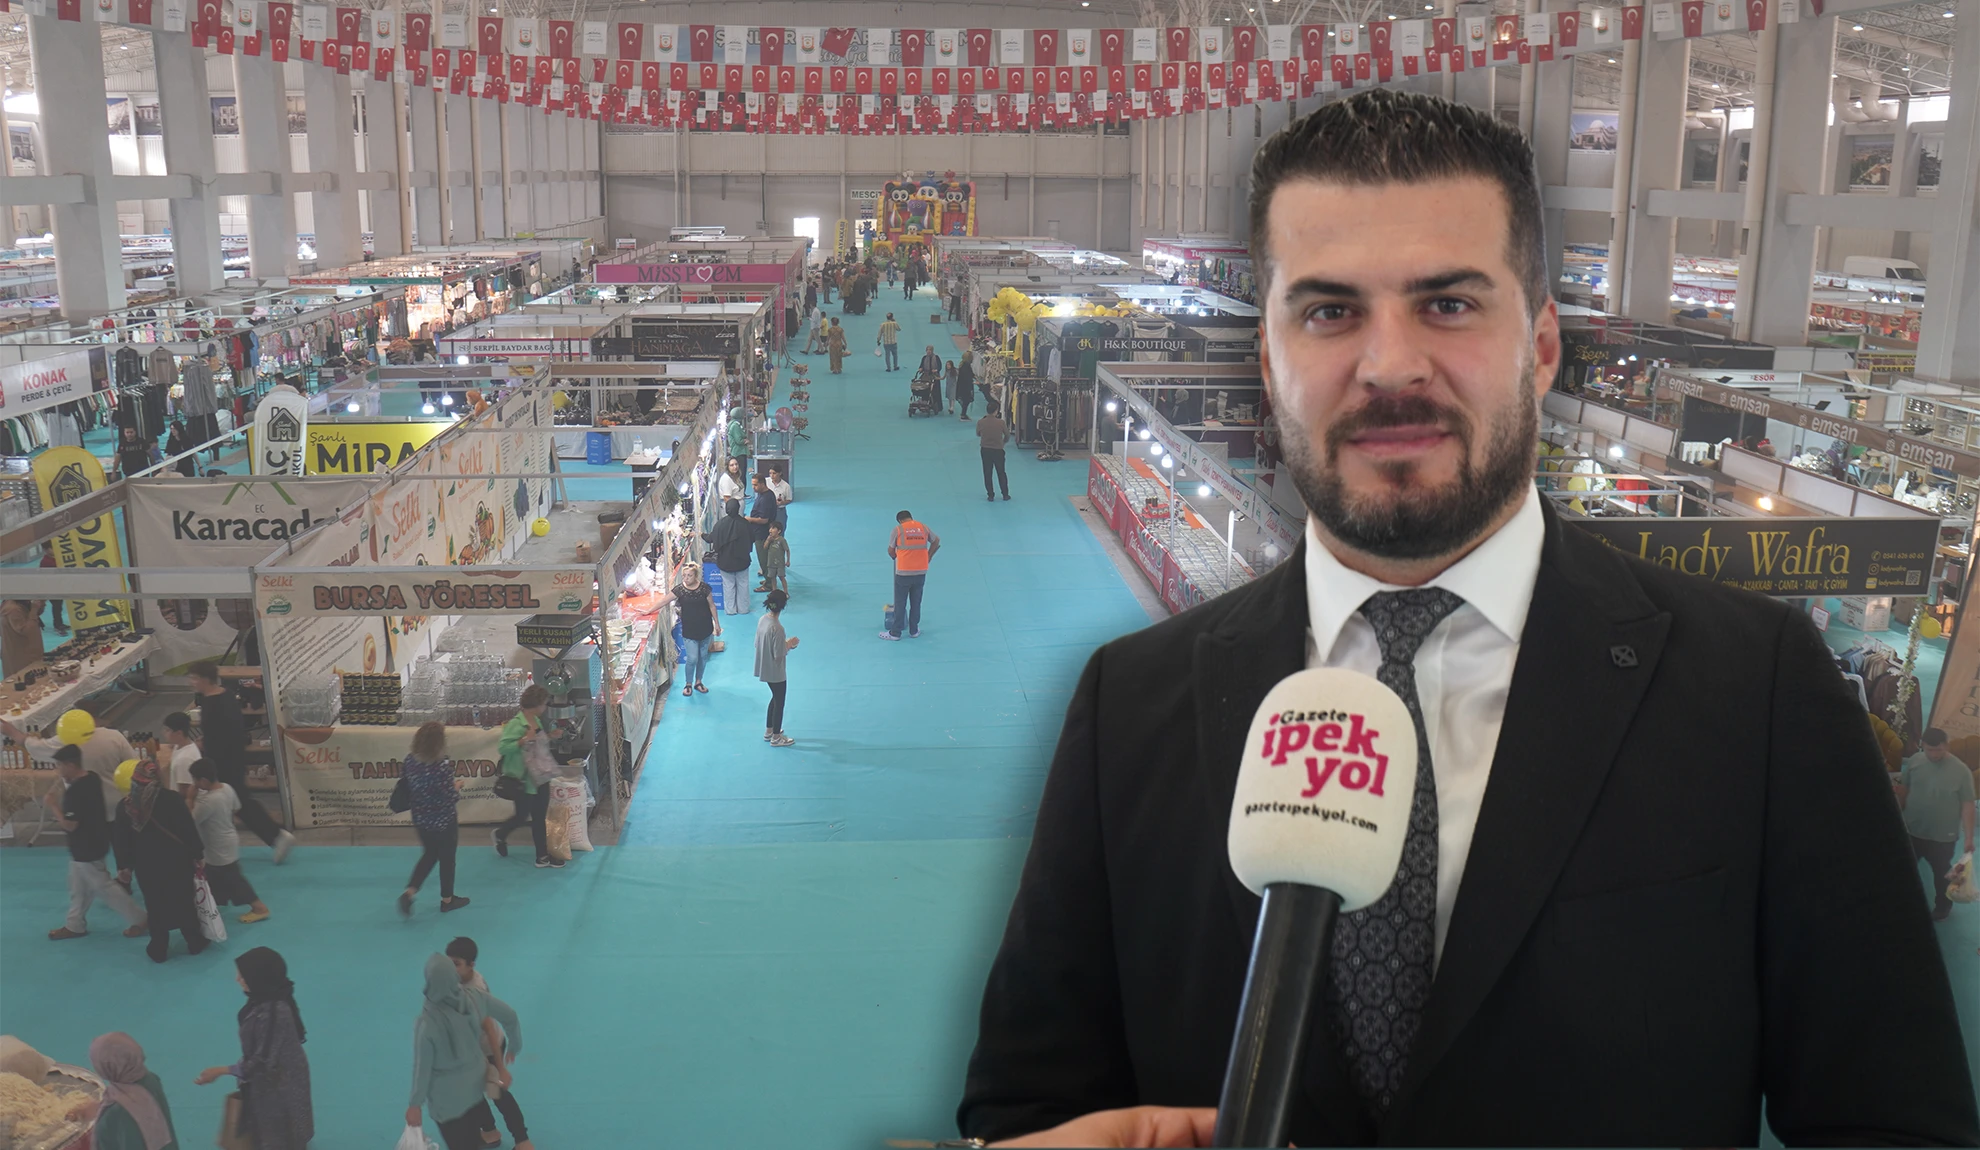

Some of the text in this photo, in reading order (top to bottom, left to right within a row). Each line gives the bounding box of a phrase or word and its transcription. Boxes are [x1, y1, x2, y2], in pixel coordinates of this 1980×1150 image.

[474, 344, 500, 352] SERPİL
[1104, 340, 1128, 349] H&K
[22, 368, 67, 391] KONAK
[1669, 376, 1703, 398] emsan
[21, 384, 72, 403] PERDE & ÇEYİZ
[1730, 393, 1770, 417] emsan
[309, 431, 347, 446] Şanlı
[1812, 414, 1858, 443] emsan
[1901, 441, 1955, 471] emsan
[255, 504, 265, 513] EC
[392, 483, 422, 543] Selki
[1638, 526, 1850, 582] Lady Wafra
[261, 575, 293, 588] Selki
[552, 572, 585, 585] Selki
[313, 585, 407, 610] BURSA
[413, 580, 540, 610] YÖRESEL
[518, 636, 571, 645] SICAK TAHİN
[1280, 709, 1348, 725] Gazete
[1261, 713, 1380, 766] ipek
[294, 746, 341, 766] Selki
[1301, 753, 1389, 797] yol
[1245, 801, 1378, 833] gazeteipekyol.com
